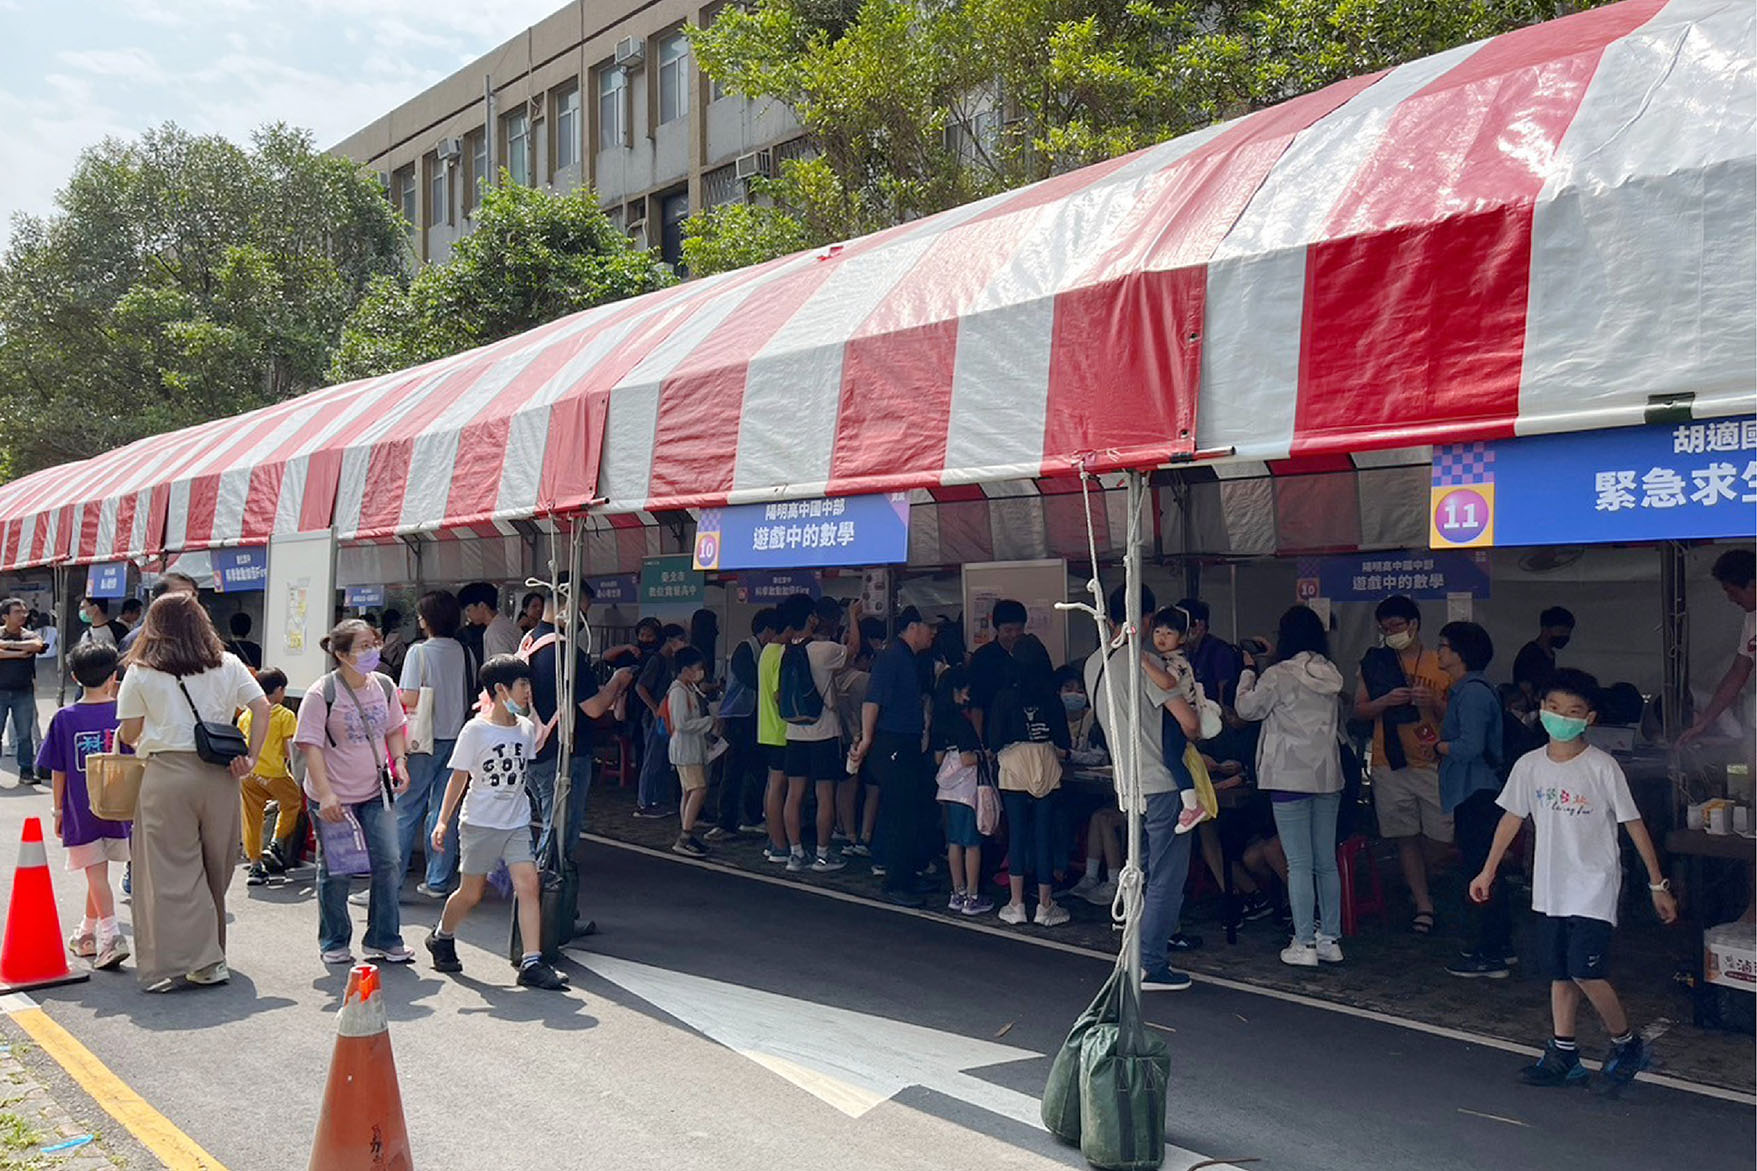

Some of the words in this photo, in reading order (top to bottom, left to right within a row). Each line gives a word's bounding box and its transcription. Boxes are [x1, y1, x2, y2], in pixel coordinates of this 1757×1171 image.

[765, 498, 846, 521] 陽明高中國中部
[1443, 503, 1479, 529] 11
[753, 522, 856, 551] 遊戲中的數學
[699, 542, 714, 559] 10
[1301, 585, 1316, 596] 10
[1353, 574, 1445, 591] 遊戲中的數學
